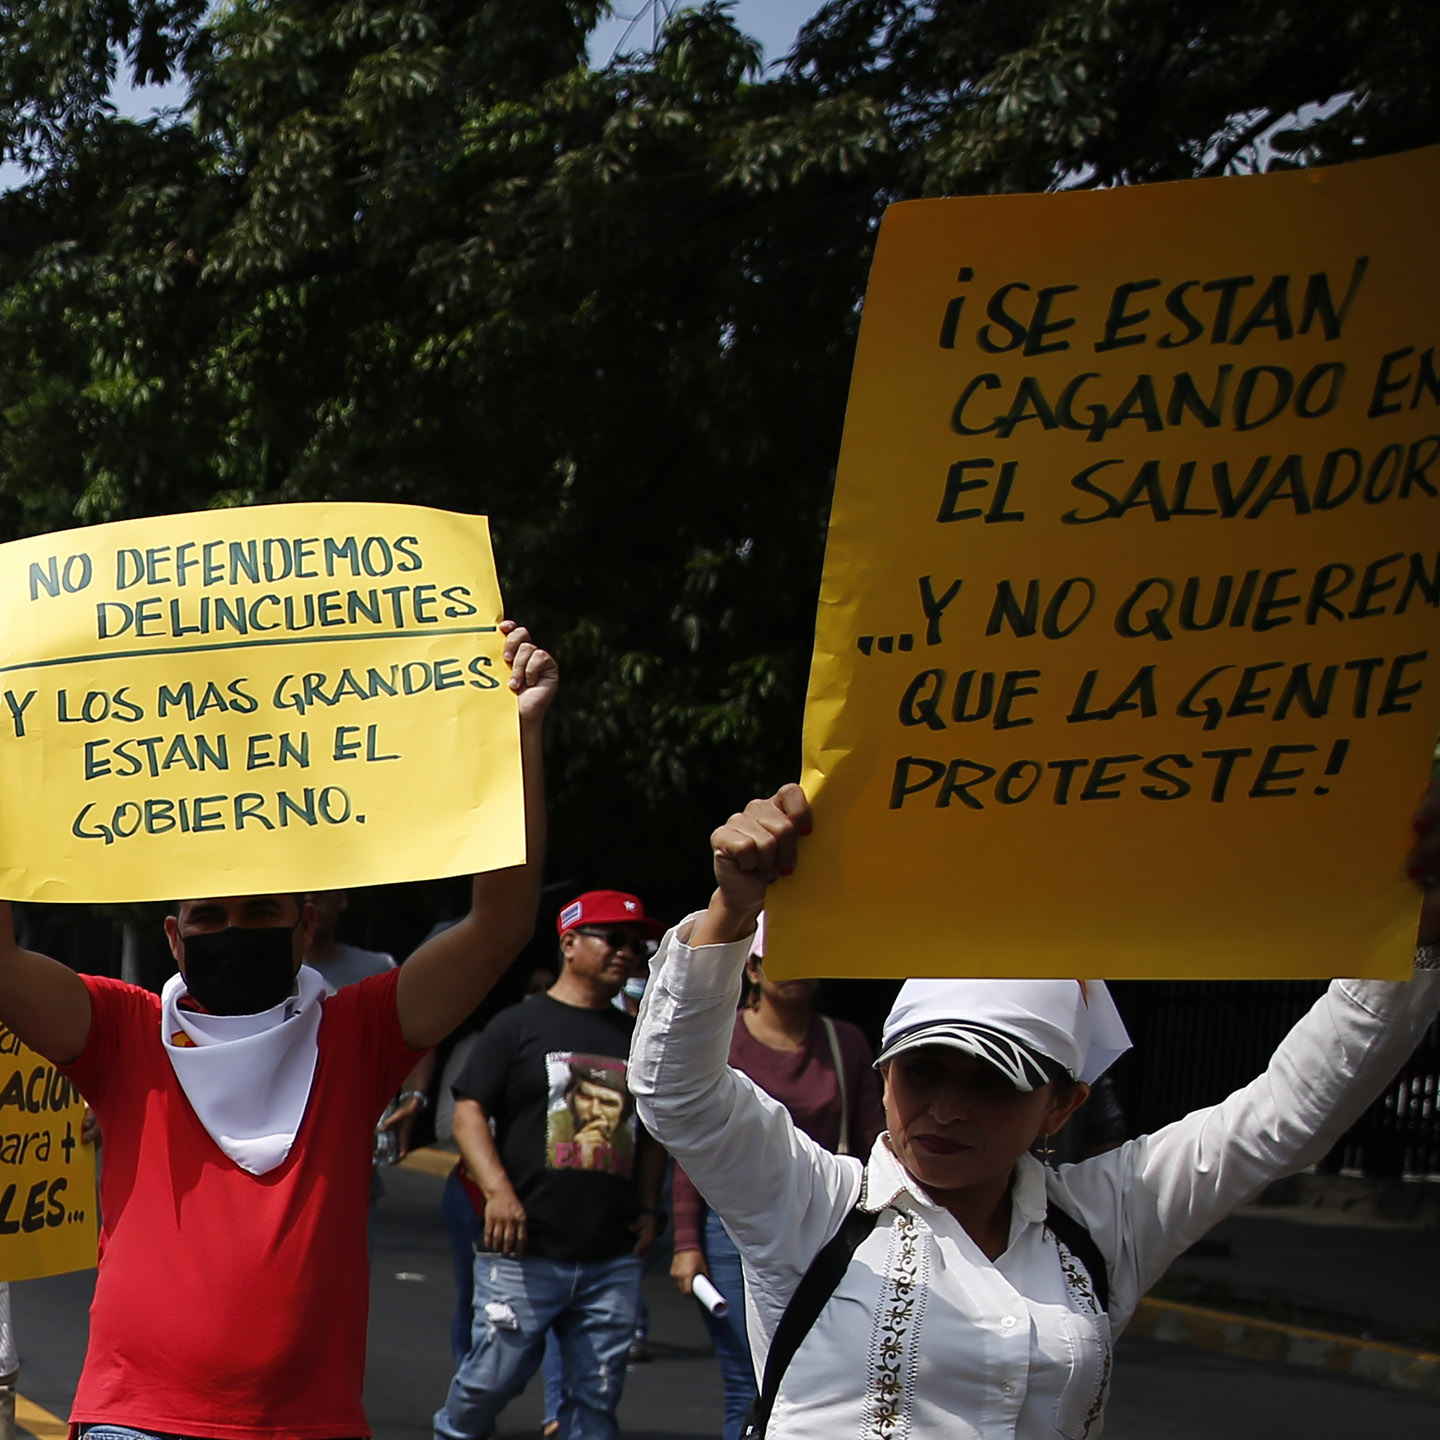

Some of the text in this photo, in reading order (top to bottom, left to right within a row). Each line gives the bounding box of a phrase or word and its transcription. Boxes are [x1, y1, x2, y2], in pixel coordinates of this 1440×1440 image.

[1094, 255, 1370, 354] ESTAN
[949, 345, 1440, 442] CAGANDO EN
[936, 434, 1440, 525] EL SALVADOR
[29, 534, 423, 602] NO DEFENDEMOS
[985, 576, 1097, 641] NO
[1114, 550, 1440, 642] QUIEREN
[96, 583, 478, 641] DELINCUENTES
[3, 655, 501, 738] Y LOS MAS GRANDES
[897, 649, 1429, 731] QUE LA GENTE
[83, 723, 402, 781] ESTAN EN EL
[888, 738, 1350, 811] PROTESTE!
[72, 784, 367, 846] GOBIERNO.
